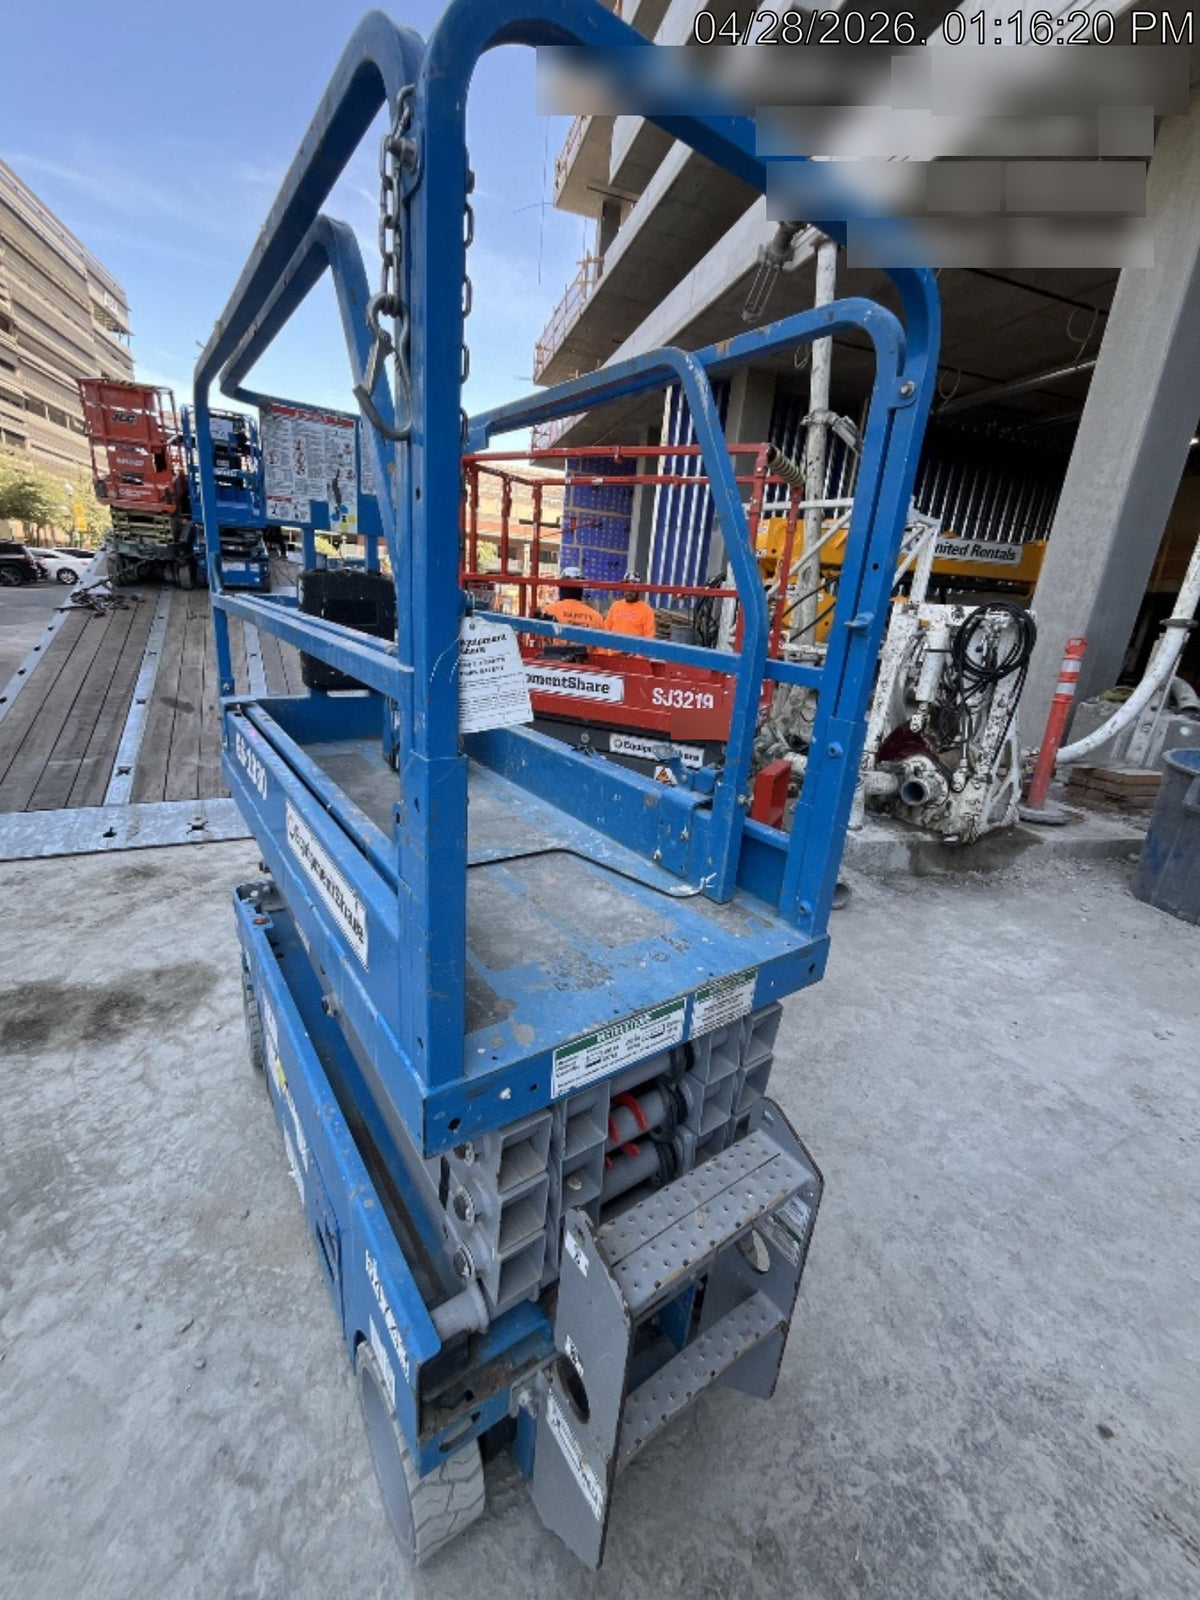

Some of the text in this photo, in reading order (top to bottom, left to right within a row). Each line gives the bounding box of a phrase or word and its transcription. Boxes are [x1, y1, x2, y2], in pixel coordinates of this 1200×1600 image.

[934, 541, 1017, 561] nited Rentals
[652, 687, 714, 709] SJ3219
